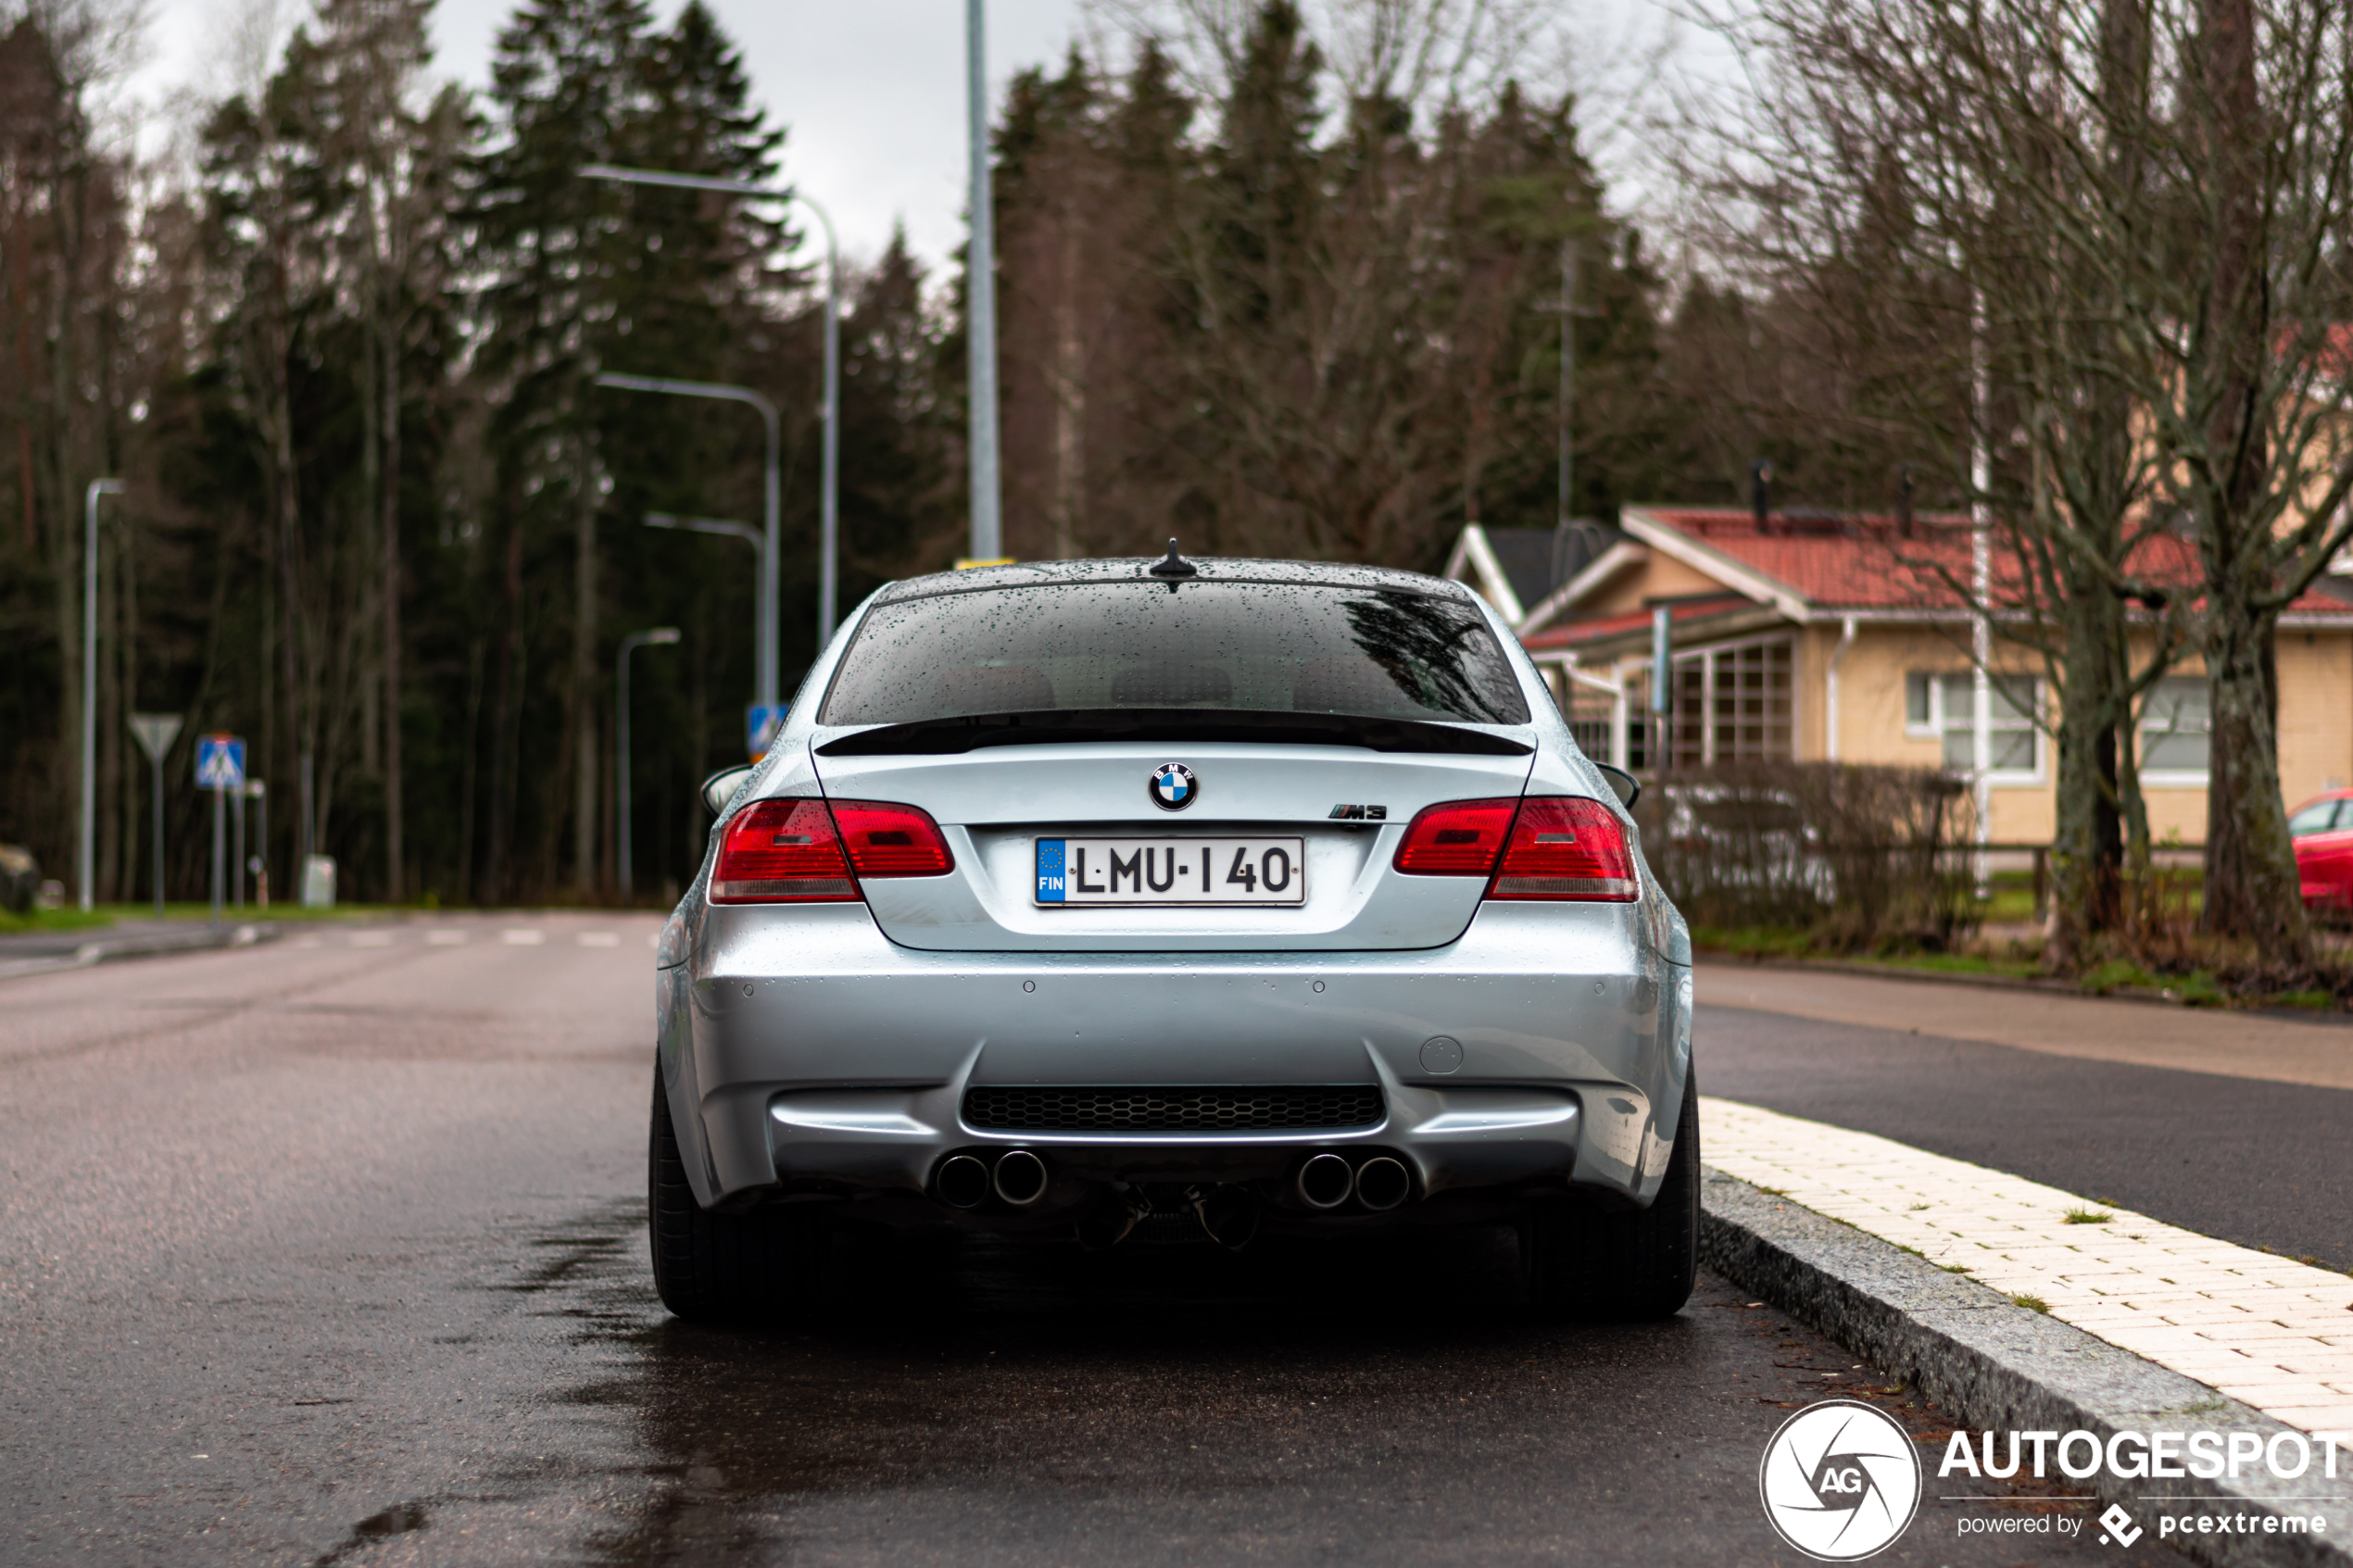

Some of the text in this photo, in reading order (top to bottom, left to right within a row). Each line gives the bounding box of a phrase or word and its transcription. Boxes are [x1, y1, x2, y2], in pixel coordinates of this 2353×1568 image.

[1154, 764, 1193, 780] BMW
[1340, 804, 1387, 820] M3
[1076, 847, 1290, 893] LMU-140
[1038, 876, 1063, 890] FIN
